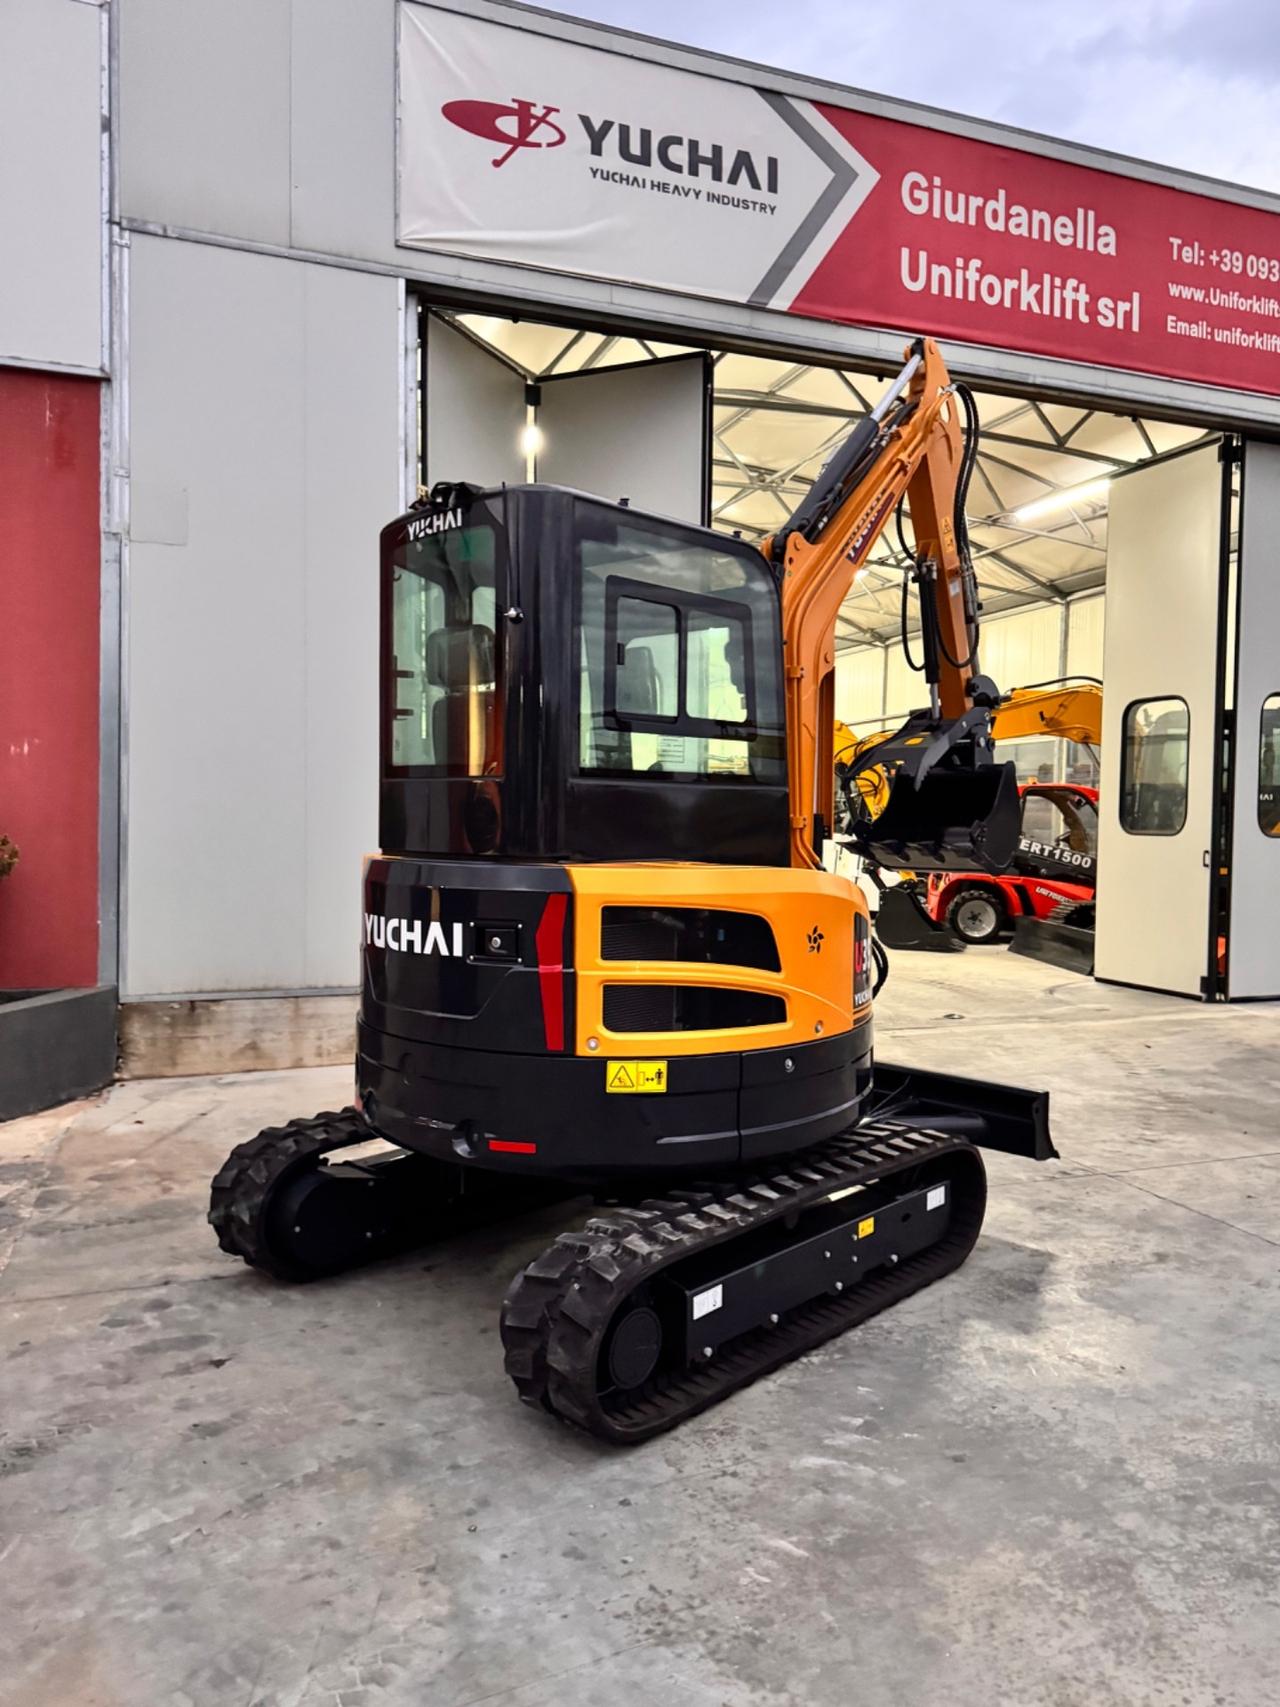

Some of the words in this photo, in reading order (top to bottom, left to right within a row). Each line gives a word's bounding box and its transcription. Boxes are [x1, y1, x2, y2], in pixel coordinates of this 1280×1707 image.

[577, 113, 778, 195] YUCHAI
[589, 166, 647, 190] YUCHAI
[650, 179, 702, 200] HEAVY
[706, 191, 777, 215] INDUSTRY
[901, 171, 1117, 256] Giurdanella
[1168, 236, 1205, 267] Tel:
[1209, 248, 1243, 274] +39
[1246, 254, 1280, 282] 093
[900, 246, 1090, 323] Uniforklift
[1096, 291, 1140, 332] srl
[1167, 314, 1212, 340] Email:
[407, 508, 462, 541] YUCHAI
[1019, 838, 1092, 868] ERT1500
[364, 912, 463, 957] YUCHAI
